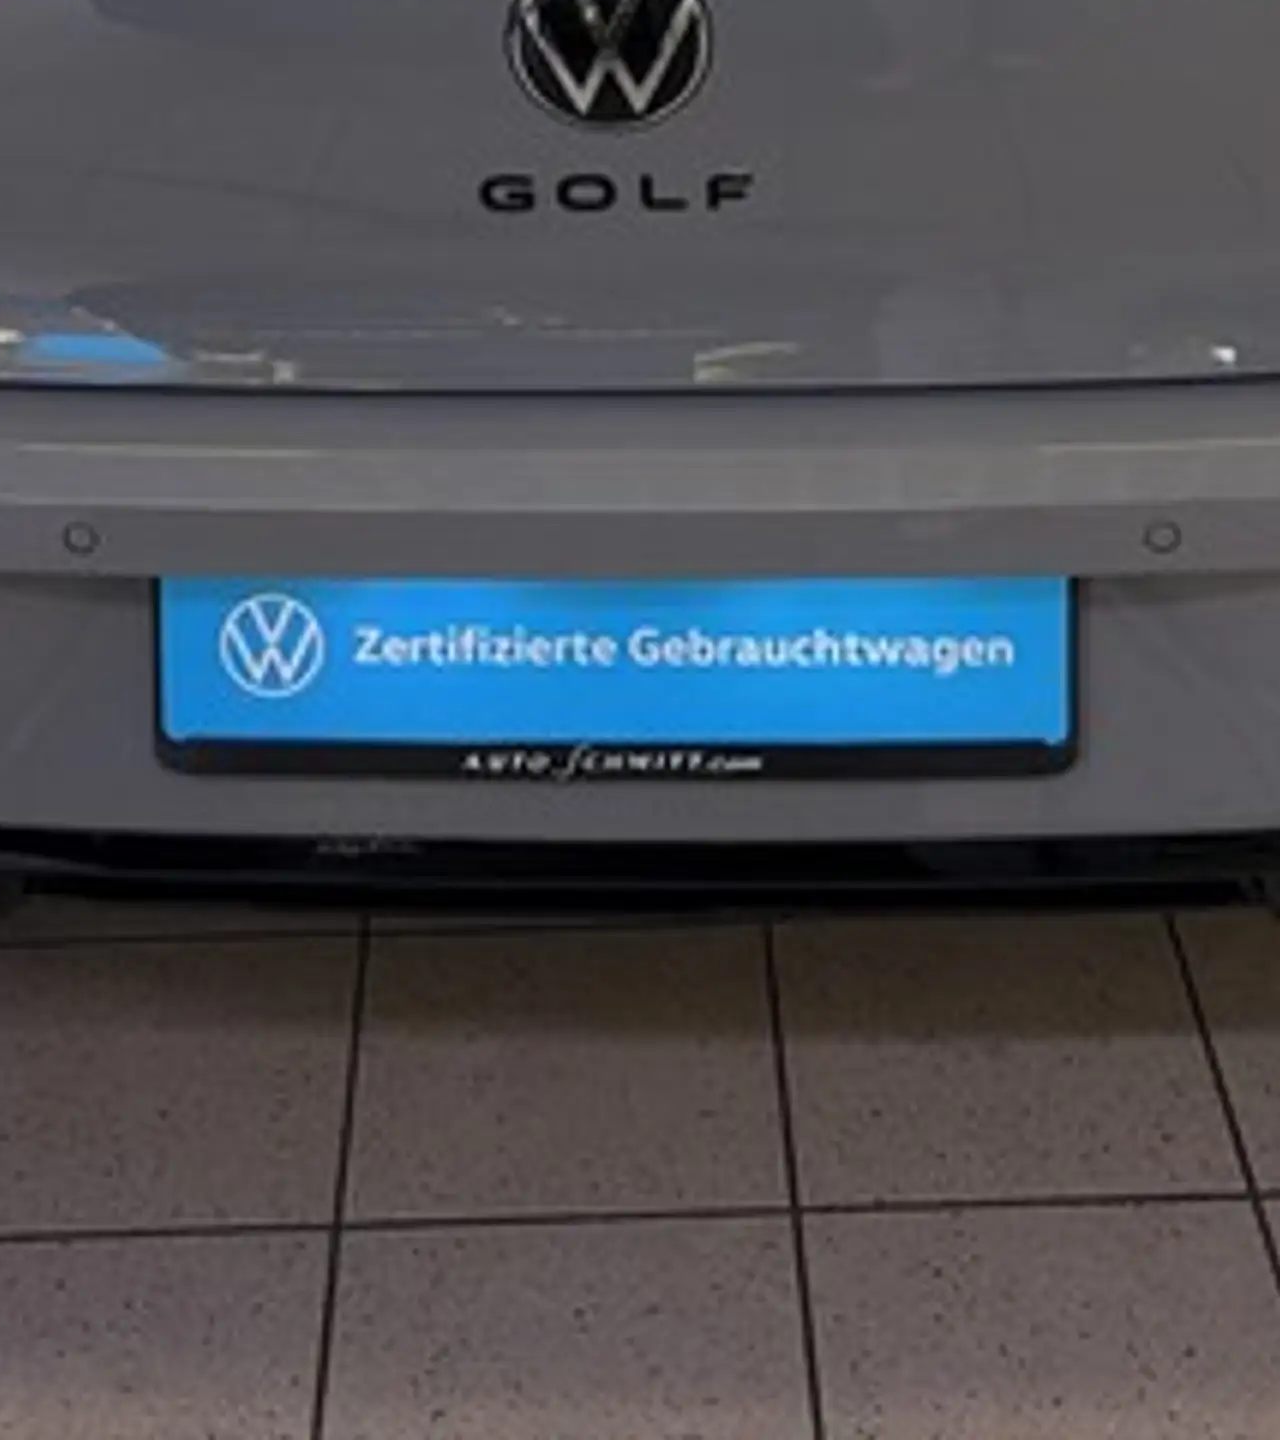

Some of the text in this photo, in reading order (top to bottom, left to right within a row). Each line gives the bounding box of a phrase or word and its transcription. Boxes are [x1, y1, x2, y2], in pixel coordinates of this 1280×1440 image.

[479, 173, 754, 212] GOLF
[353, 624, 1015, 678] Zertifizierte Gebrauchtwagen
[462, 751, 550, 773] AUTO
